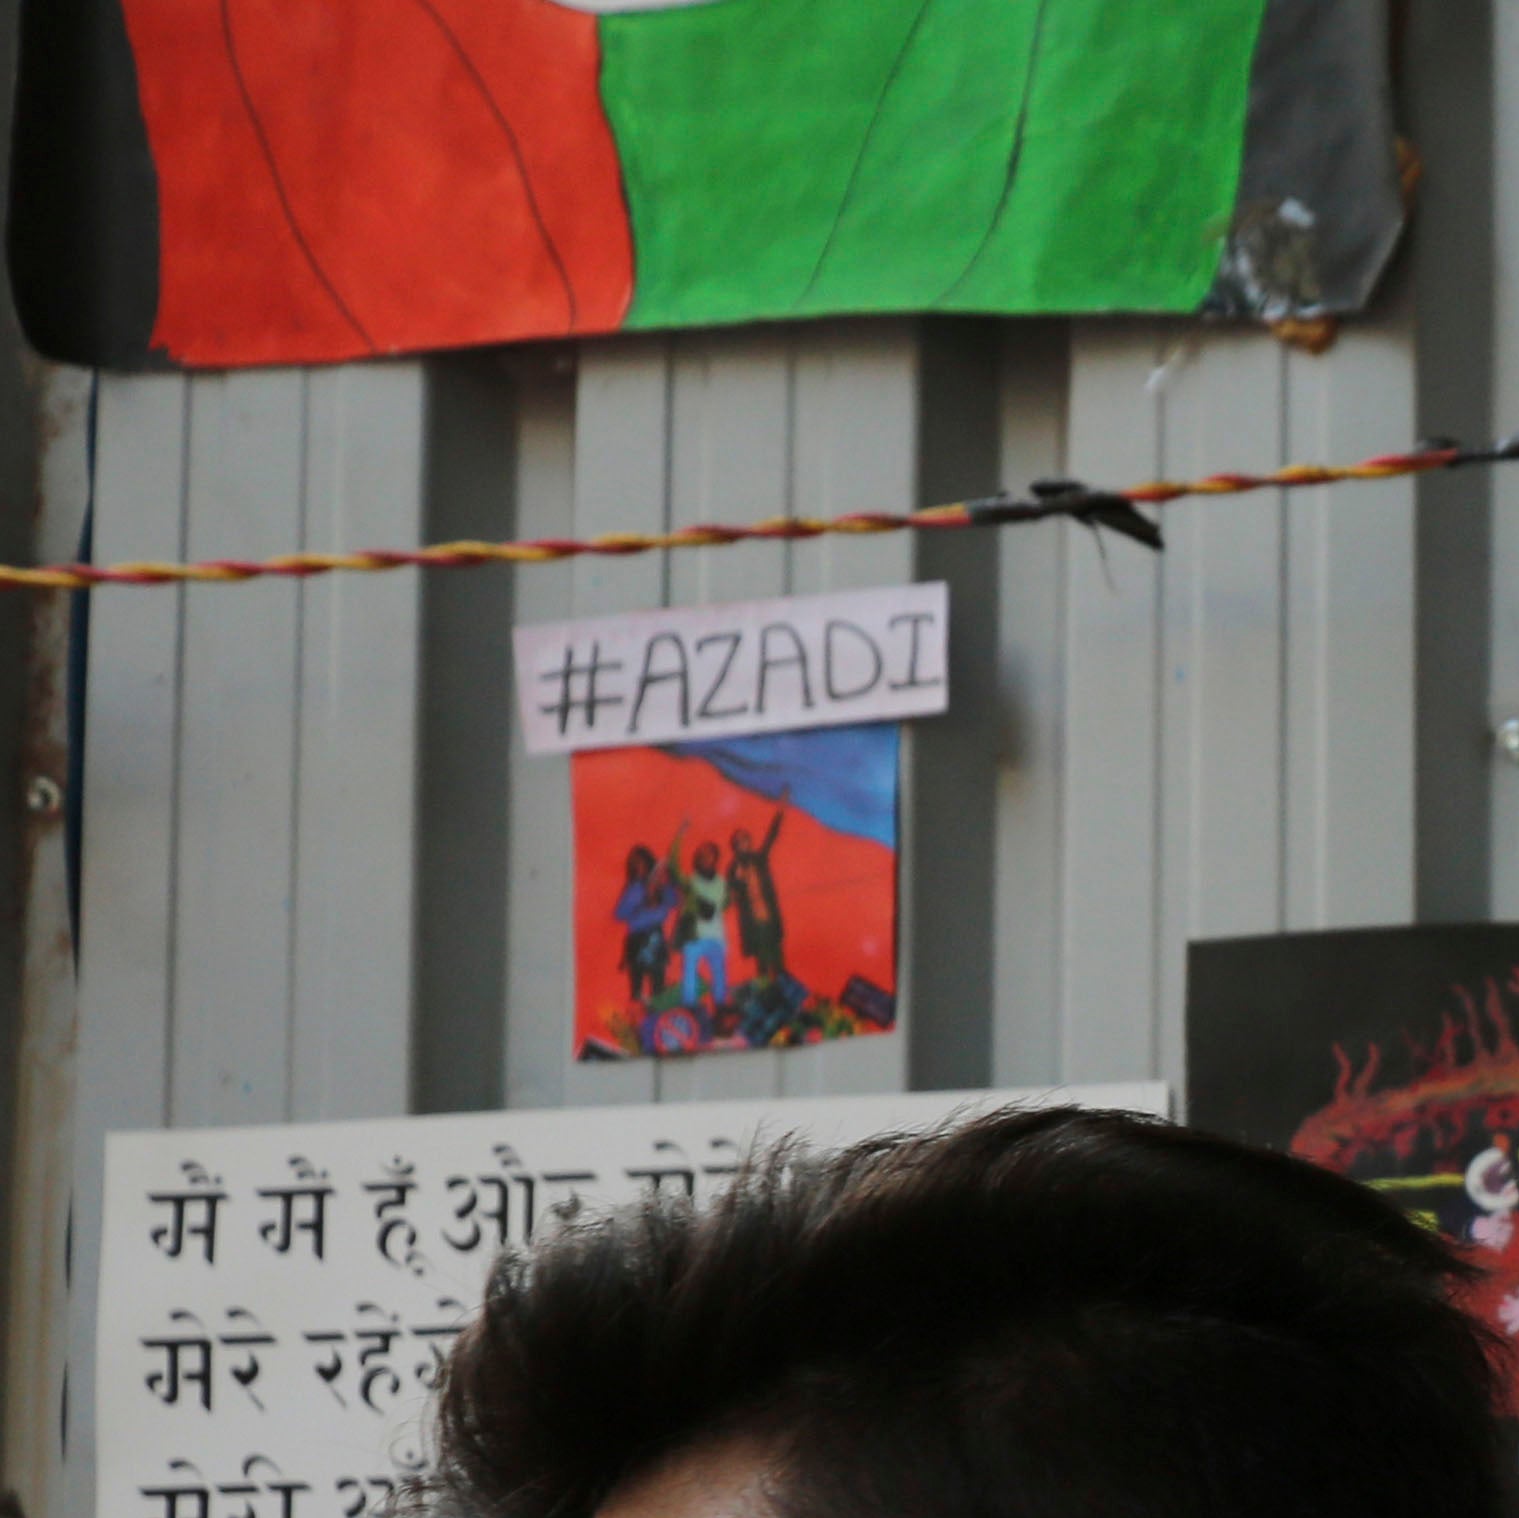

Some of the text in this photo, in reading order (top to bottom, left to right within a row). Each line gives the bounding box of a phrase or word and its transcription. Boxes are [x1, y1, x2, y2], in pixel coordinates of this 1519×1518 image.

[539, 612, 942, 736] #AZADI
[148, 1157, 228, 1266] मैं
[255, 1154, 336, 1264] मैं
[139, 1308, 277, 1414] मेरे
